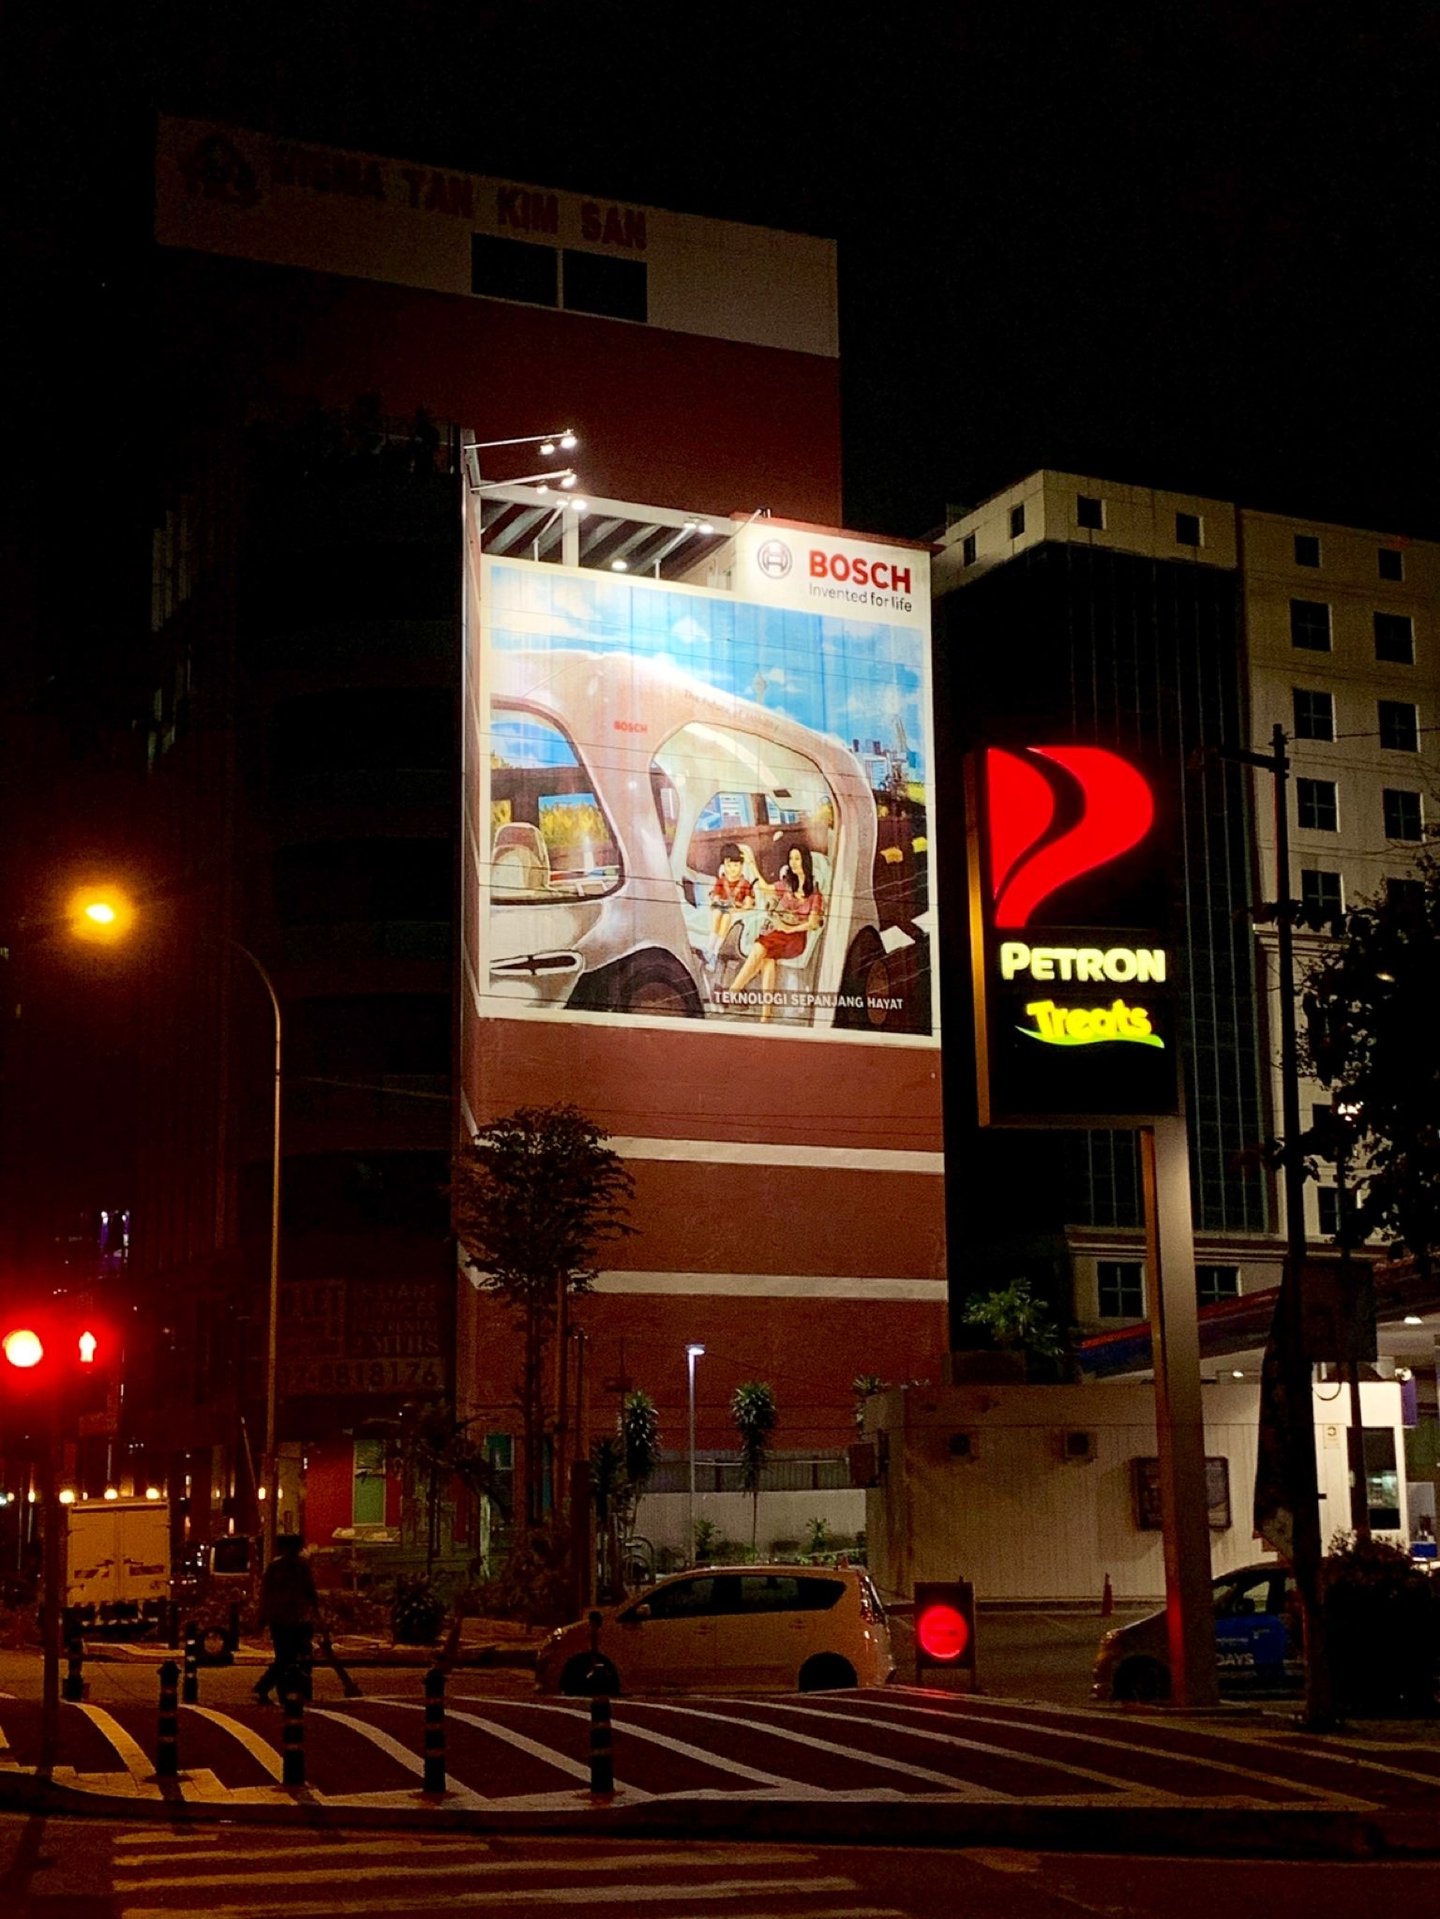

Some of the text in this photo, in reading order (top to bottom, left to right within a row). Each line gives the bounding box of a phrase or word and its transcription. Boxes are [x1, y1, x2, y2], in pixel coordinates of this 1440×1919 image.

[400, 168, 473, 220] TAN
[497, 184, 559, 235] KIM
[582, 202, 648, 251] SAN
[810, 550, 911, 594] BOSCH
[809, 583, 913, 612] Invented for life
[613, 719, 649, 734] BOSCH
[1000, 941, 1167, 983] PETRON
[713, 991, 905, 1010] TEKNOLOGI SEPANJANG HAYAT
[1026, 998, 1153, 1040] Treats
